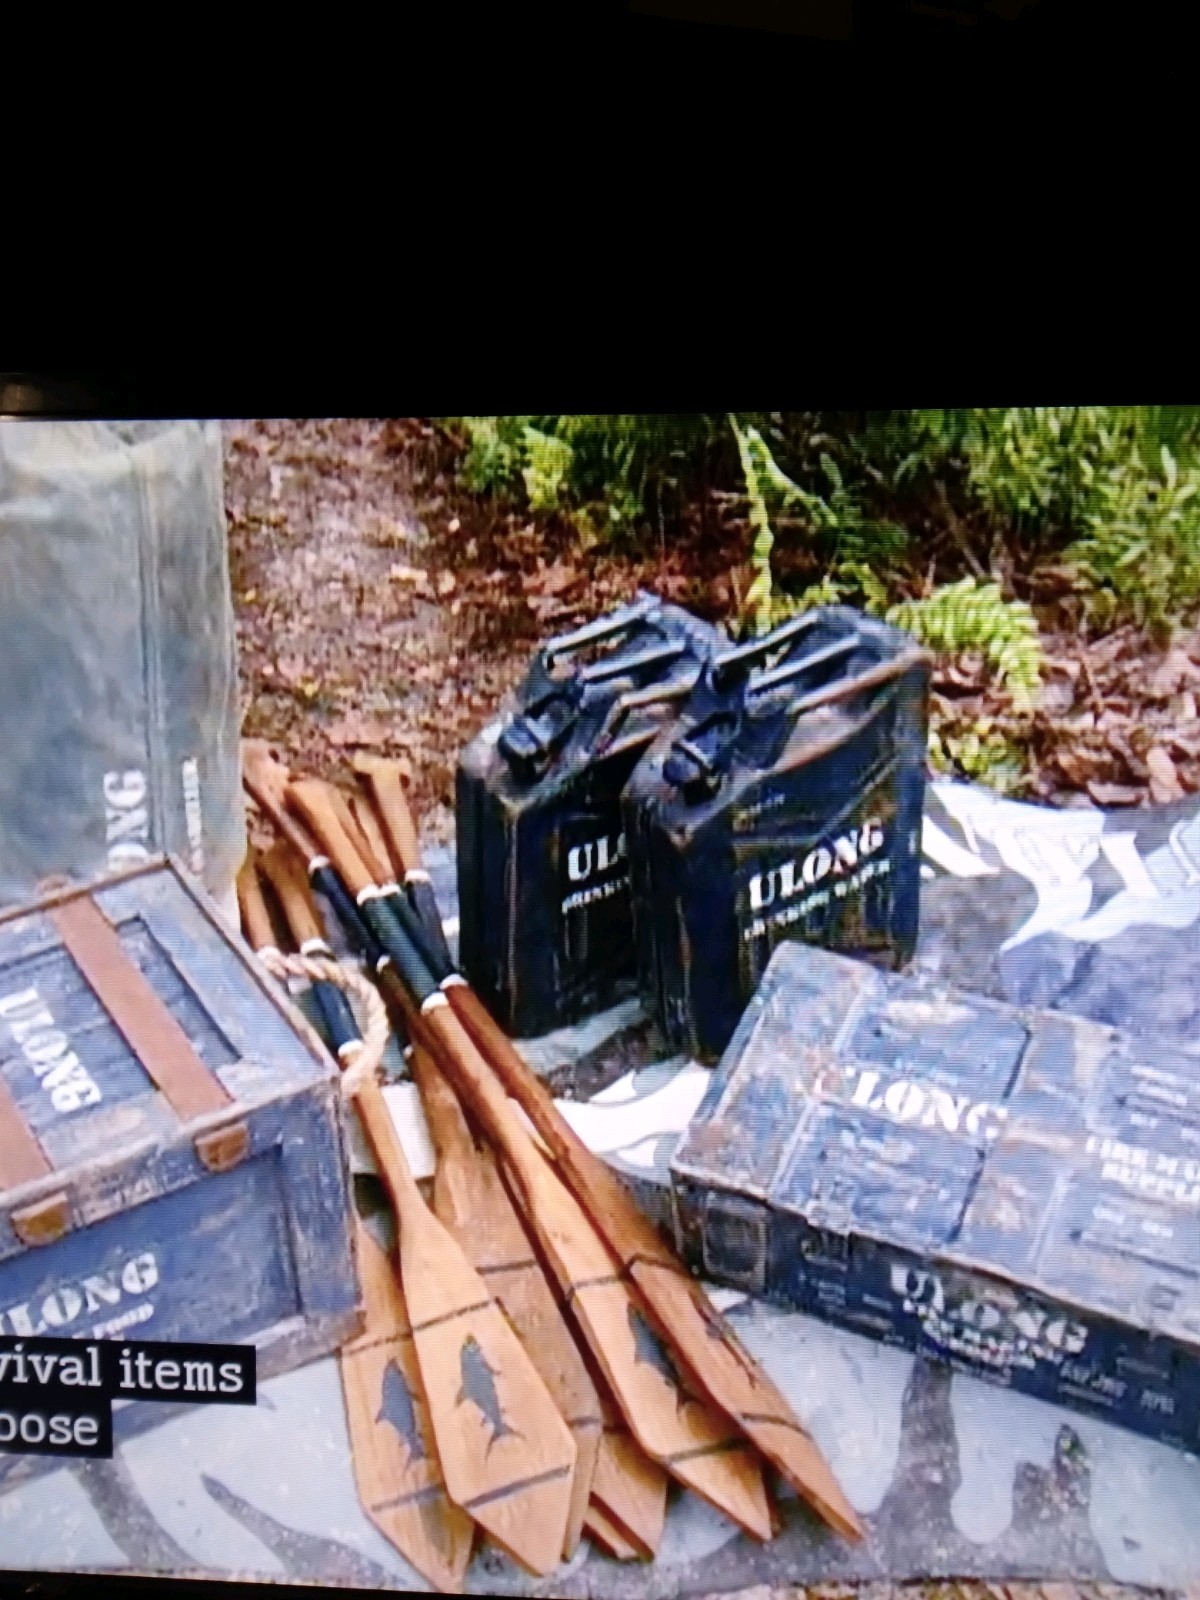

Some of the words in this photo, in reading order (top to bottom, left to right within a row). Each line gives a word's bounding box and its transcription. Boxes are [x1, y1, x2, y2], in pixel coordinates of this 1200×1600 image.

[748, 817, 884, 911] ULONG
[0, 1252, 158, 1337] LONG
[118, 1348, 243, 1393] items
